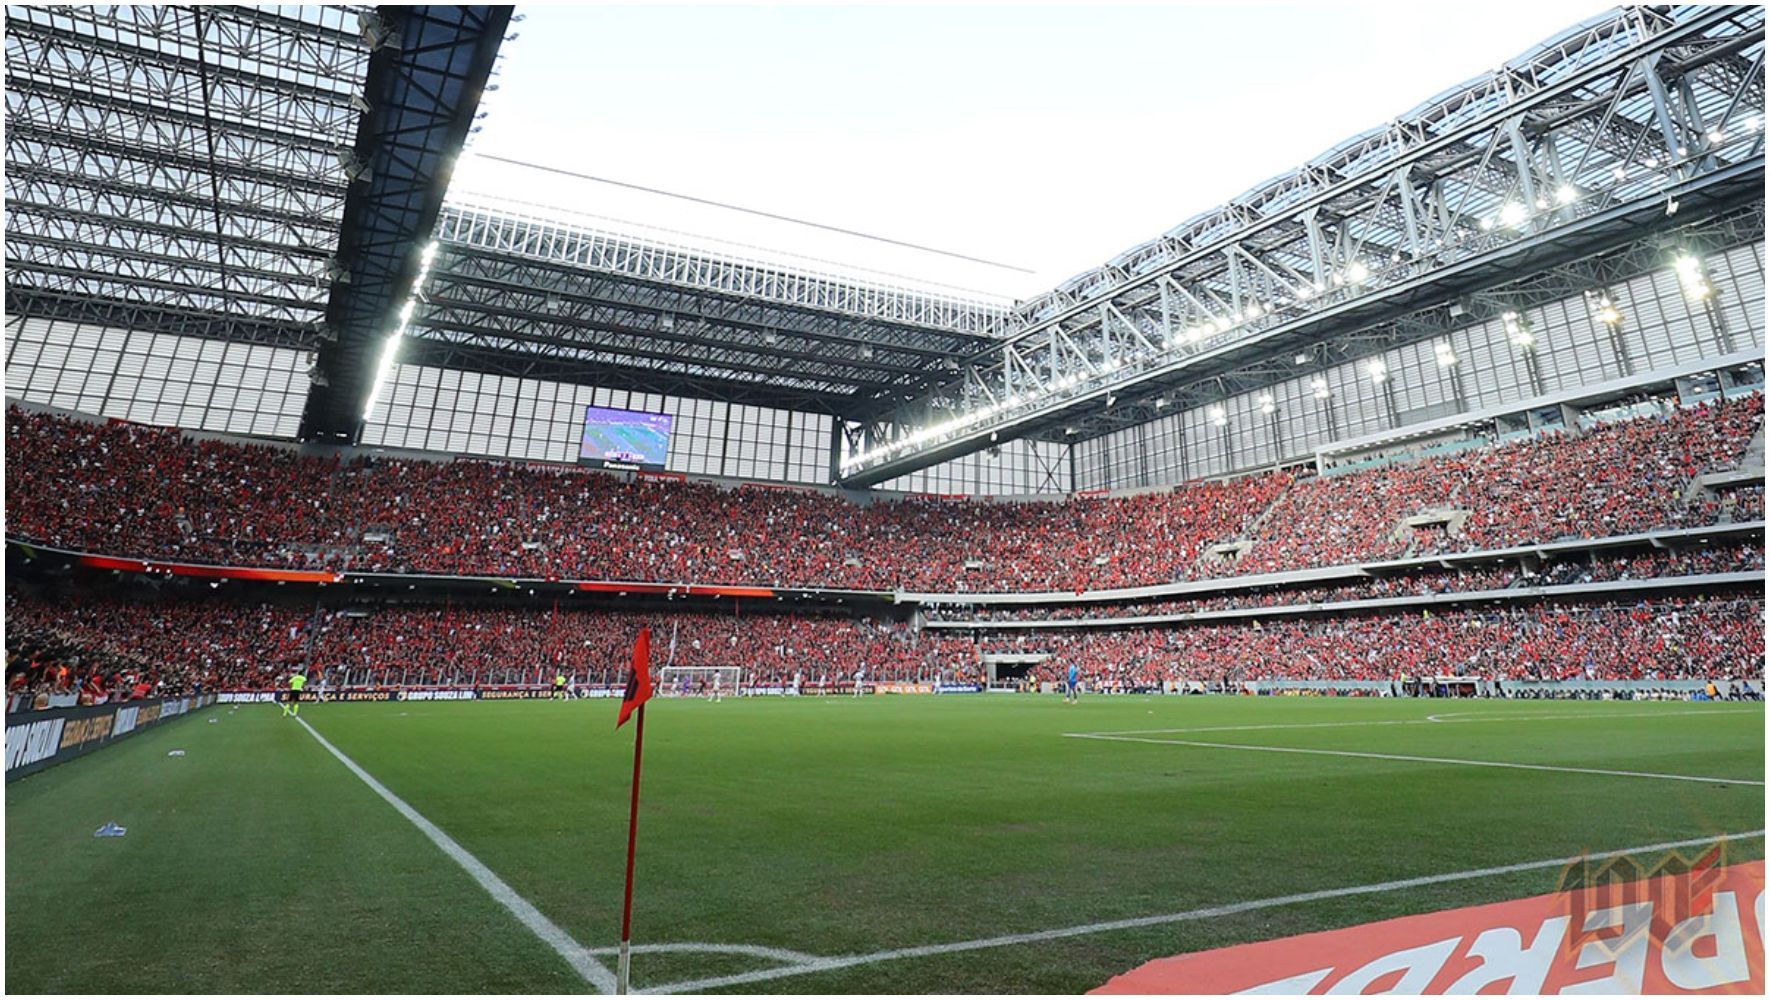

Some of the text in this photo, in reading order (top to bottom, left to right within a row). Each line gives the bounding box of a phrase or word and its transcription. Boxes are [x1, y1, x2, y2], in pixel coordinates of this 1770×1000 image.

[347, 692, 390, 702] SERVIÇOS
[408, 691, 433, 701] GRUPO
[434, 691, 458, 700] SOUZA
[482, 690, 528, 700] SEGURANÇA
